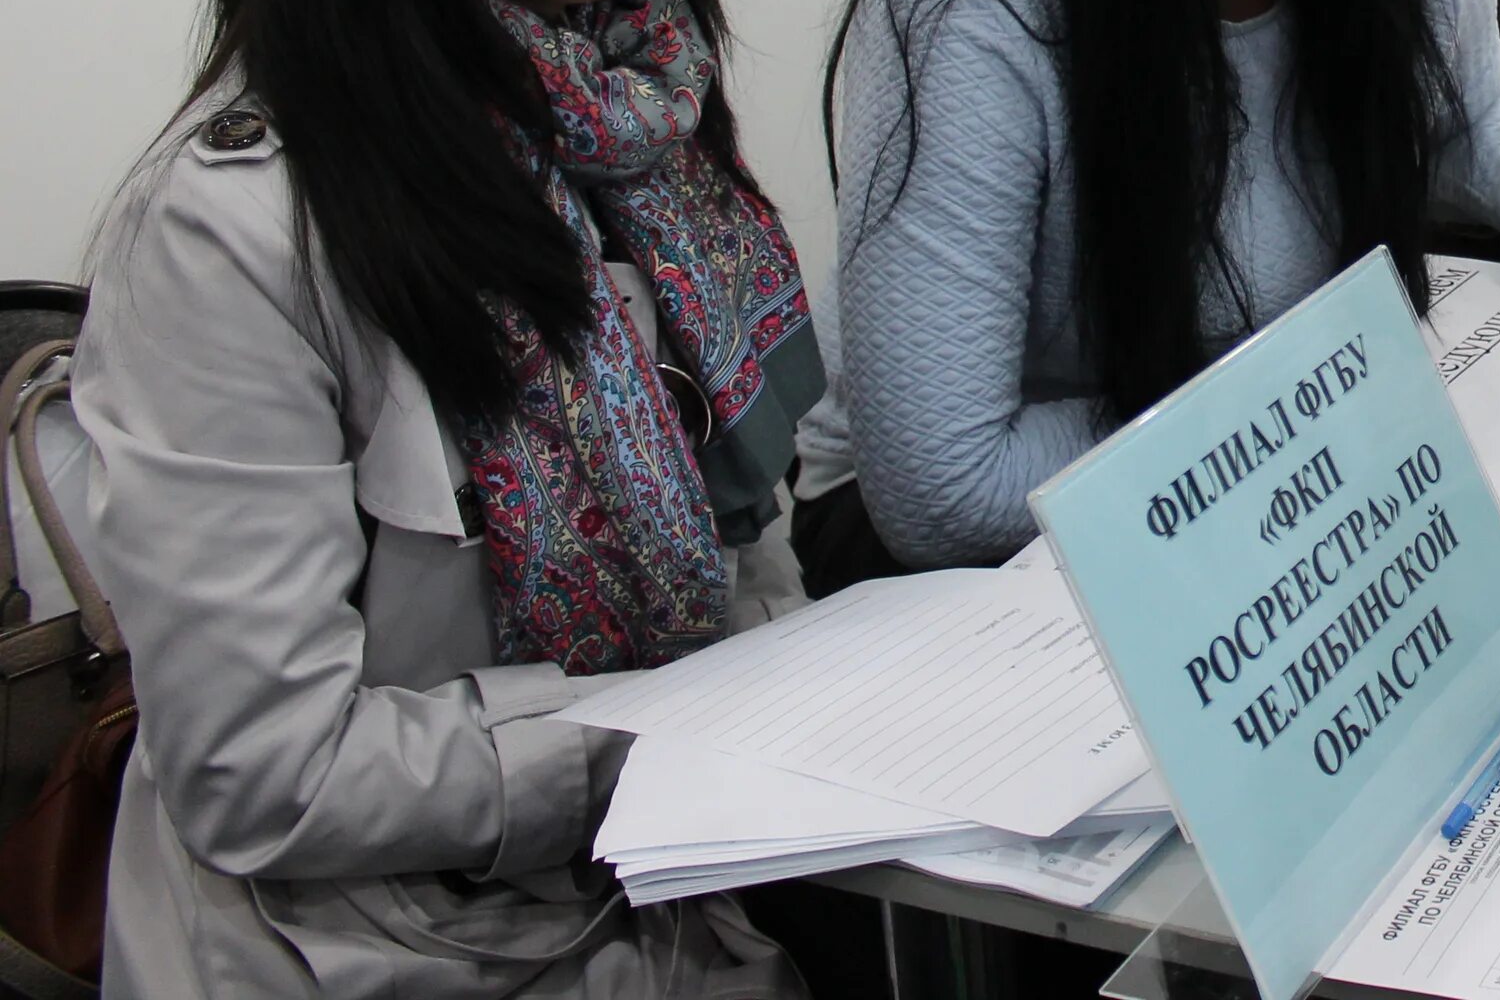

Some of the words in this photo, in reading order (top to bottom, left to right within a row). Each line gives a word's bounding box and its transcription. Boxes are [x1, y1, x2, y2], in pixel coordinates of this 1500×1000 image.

[1145, 397, 1298, 543] ФИЛИАЛ
[1293, 333, 1373, 422] ФГБУ
[1259, 445, 1347, 548] «ФКП
[1183, 494, 1402, 711] РОСРЕЕСТРА»
[1396, 442, 1443, 508] ПО
[1231, 503, 1461, 752] ЧЕЛЯБИНСКОЙ
[1312, 605, 1456, 778] ОБЛАСТИ
[1382, 887, 1430, 942] ФИЛИАЛ
[1421, 854, 1452, 887] ФГБУ
[1418, 906, 1442, 927] ПО
[1436, 816, 1499, 905] ЧЕЛЯБИНСКОЙ
